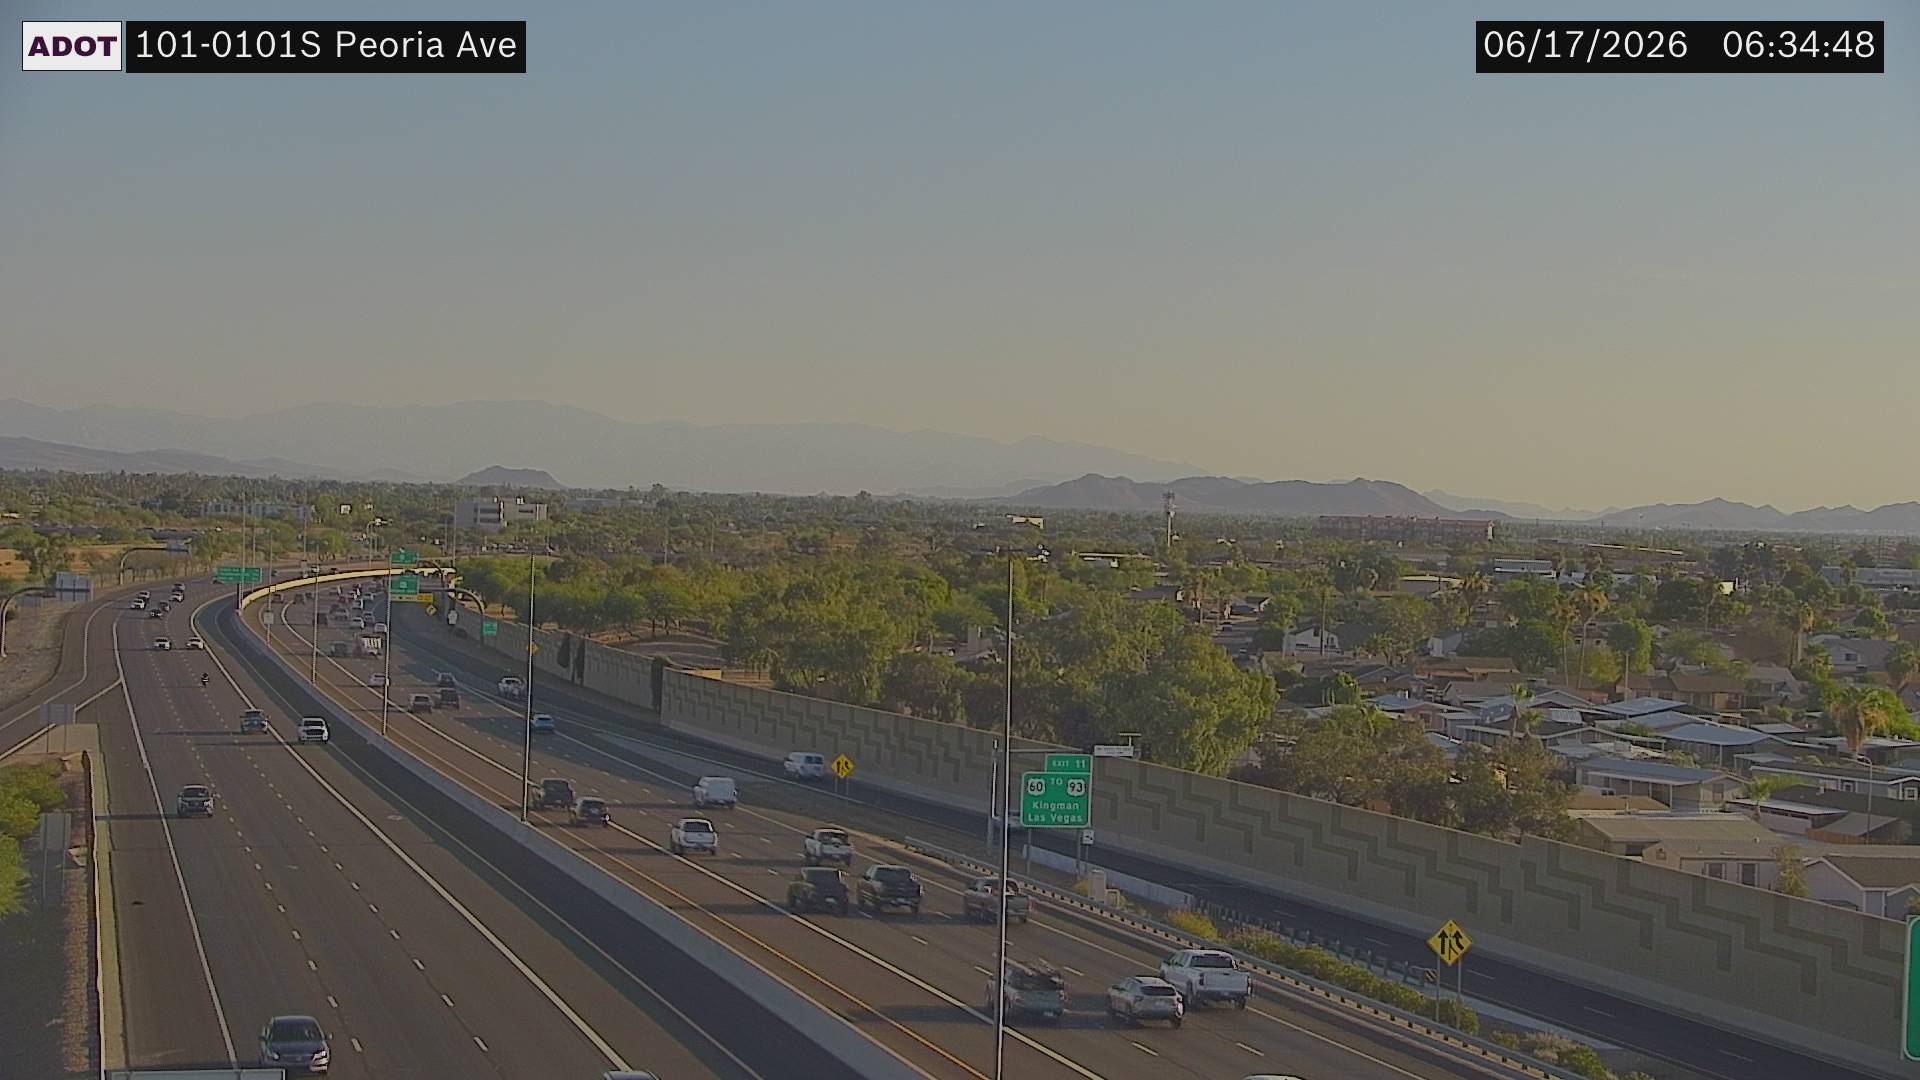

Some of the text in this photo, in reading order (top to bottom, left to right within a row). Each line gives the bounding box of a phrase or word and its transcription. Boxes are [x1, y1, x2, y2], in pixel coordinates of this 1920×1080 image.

[1075, 760, 1086, 768] 11
[1029, 777, 1083, 792] 60 TO 93
[1032, 801, 1080, 811] Kingman
[1028, 813, 1083, 824] Las Vegas
